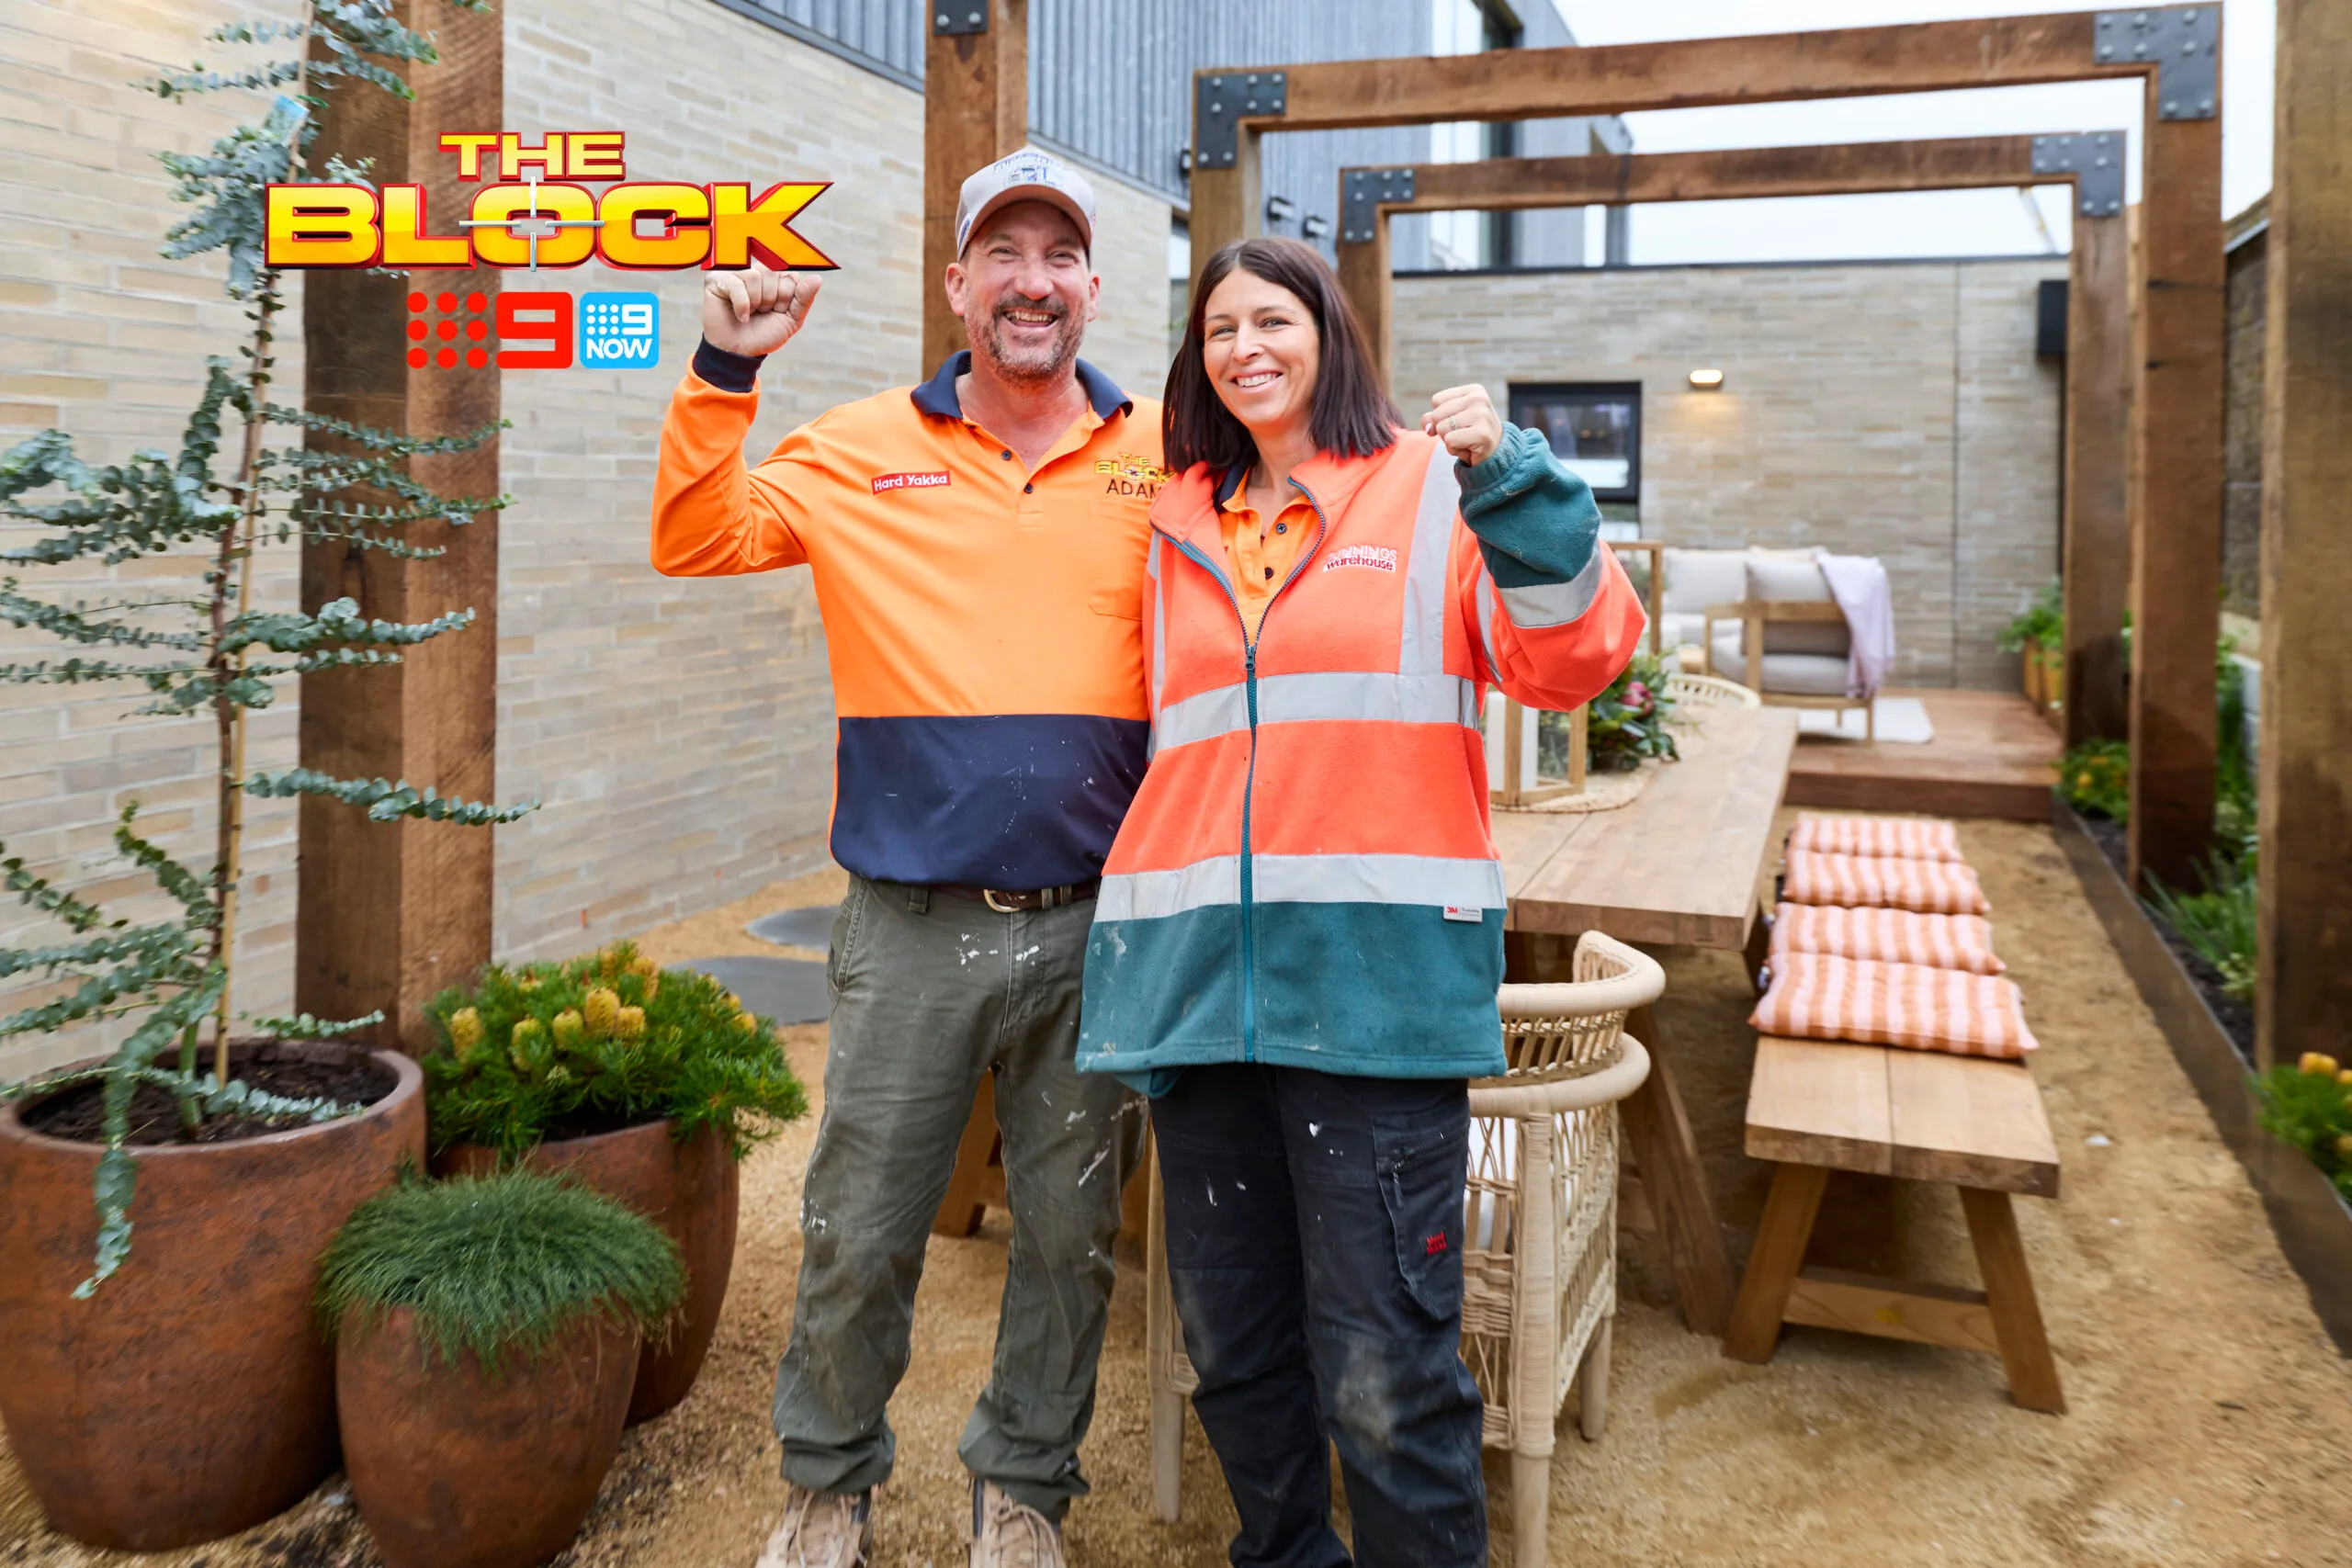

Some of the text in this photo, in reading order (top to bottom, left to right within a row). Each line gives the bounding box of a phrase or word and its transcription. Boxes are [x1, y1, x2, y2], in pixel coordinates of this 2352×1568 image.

[1119, 453, 1150, 467] THE
[874, 474, 947, 492] Hard Yakka
[1327, 554, 1393, 570] warehouse
[1446, 906, 1458, 914] 3M
